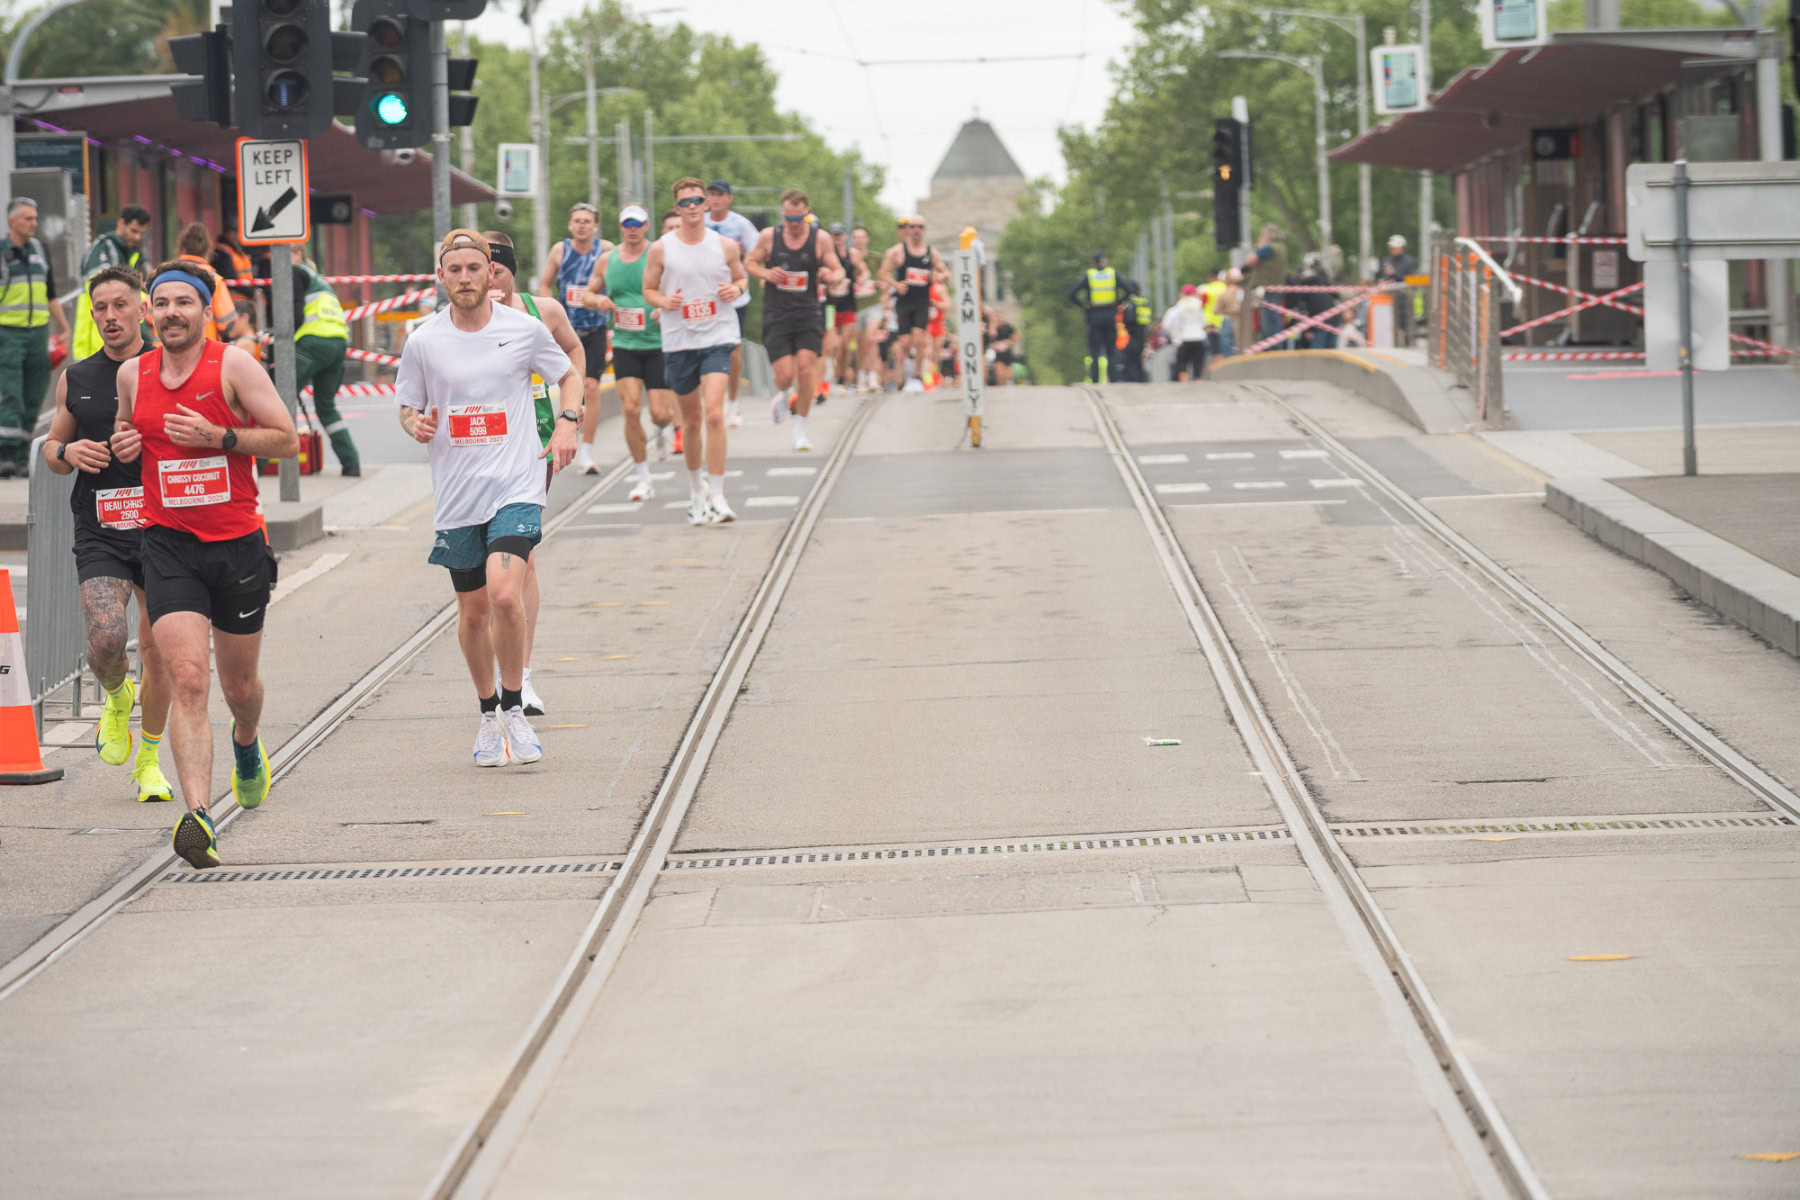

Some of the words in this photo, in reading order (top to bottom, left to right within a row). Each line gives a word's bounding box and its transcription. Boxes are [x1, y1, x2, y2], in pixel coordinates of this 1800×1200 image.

[253, 149, 293, 165] KEEP
[255, 169, 292, 185] LEFT
[960, 256, 976, 323] TRAM
[687, 303, 712, 318] 8135
[964, 342, 980, 409] ONLY
[470, 416, 486, 426] JACK
[470, 427, 487, 436] 5099
[167, 474, 192, 484] CHRISSY
[193, 471, 220, 482] COCONUT
[184, 484, 205, 495] 4476
[104, 501, 122, 511] BEAU
[168, 496, 206, 506] MELBOURNE
[207, 494, 225, 503] 2025
